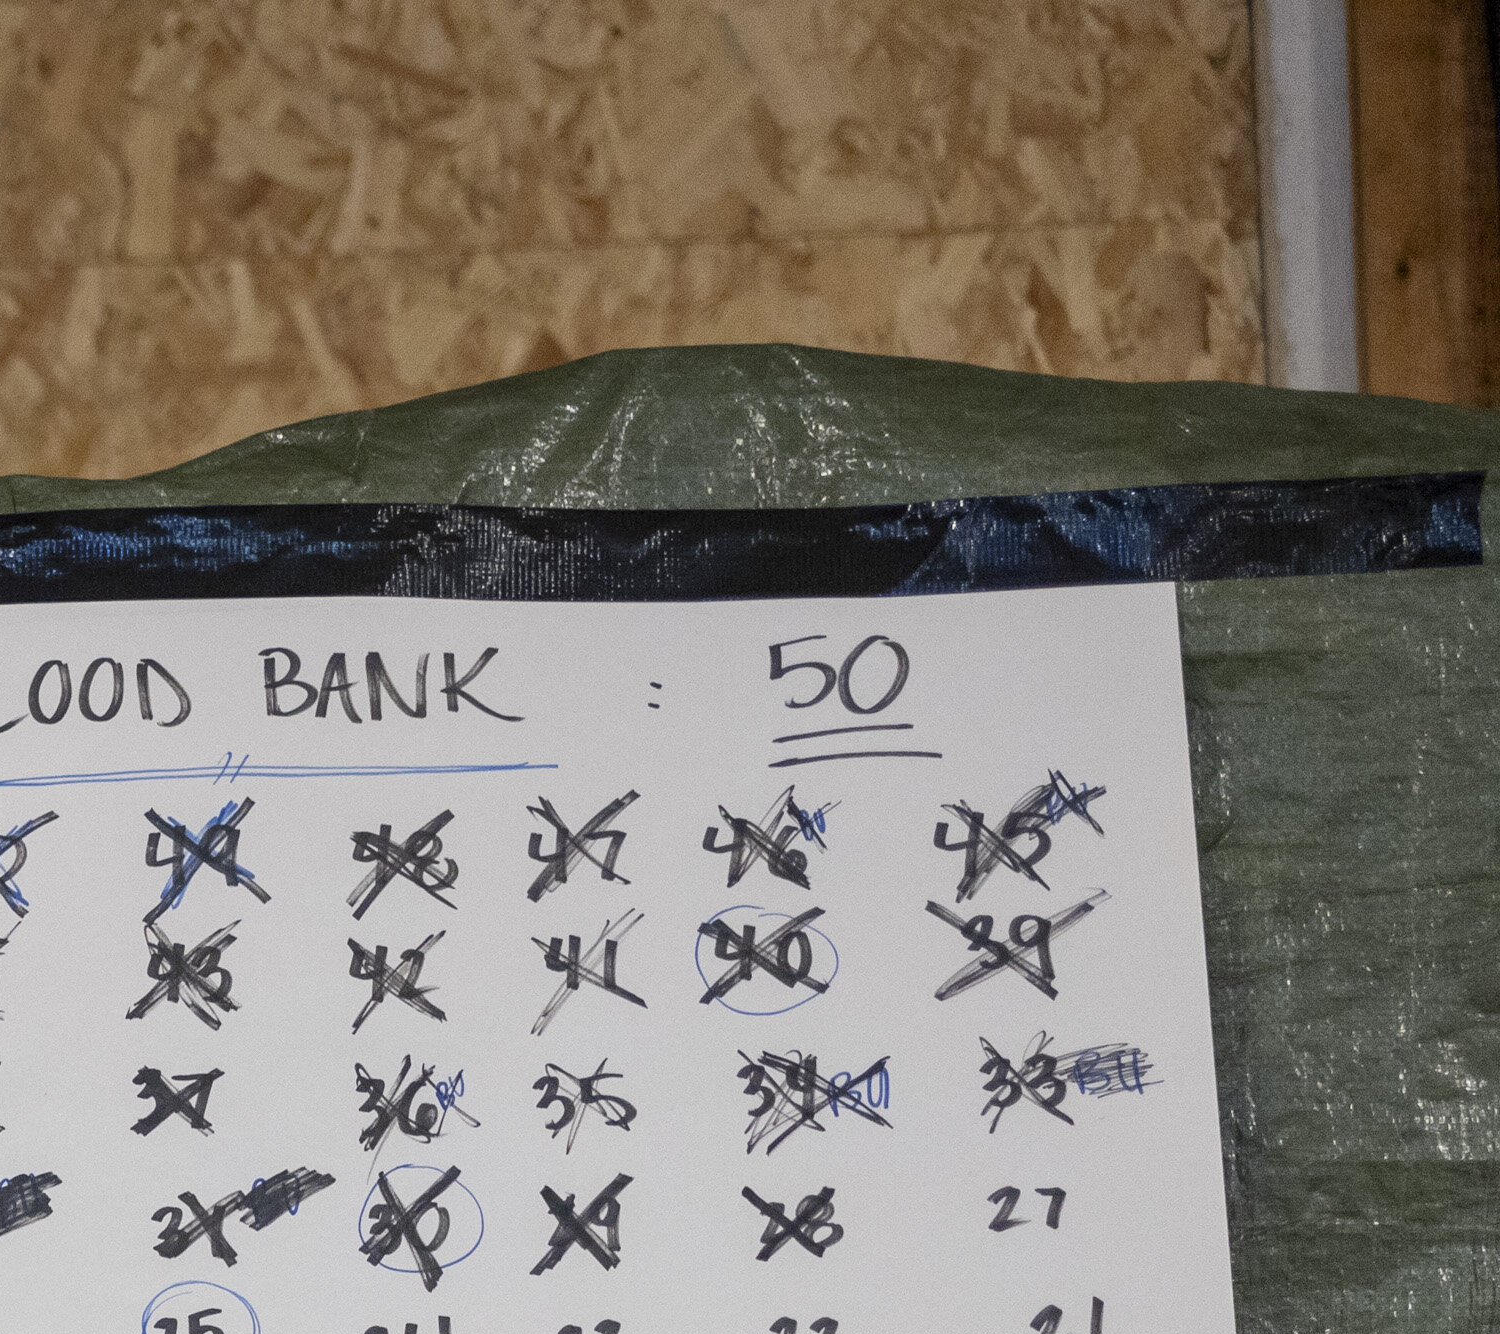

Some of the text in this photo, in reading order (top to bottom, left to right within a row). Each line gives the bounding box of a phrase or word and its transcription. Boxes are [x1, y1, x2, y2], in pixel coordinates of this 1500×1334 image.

[258, 647, 526, 724] BANK
[768, 635, 910, 714] 50
[531, 1071, 638, 1132] 35
[987, 1186, 1067, 1233] 27
